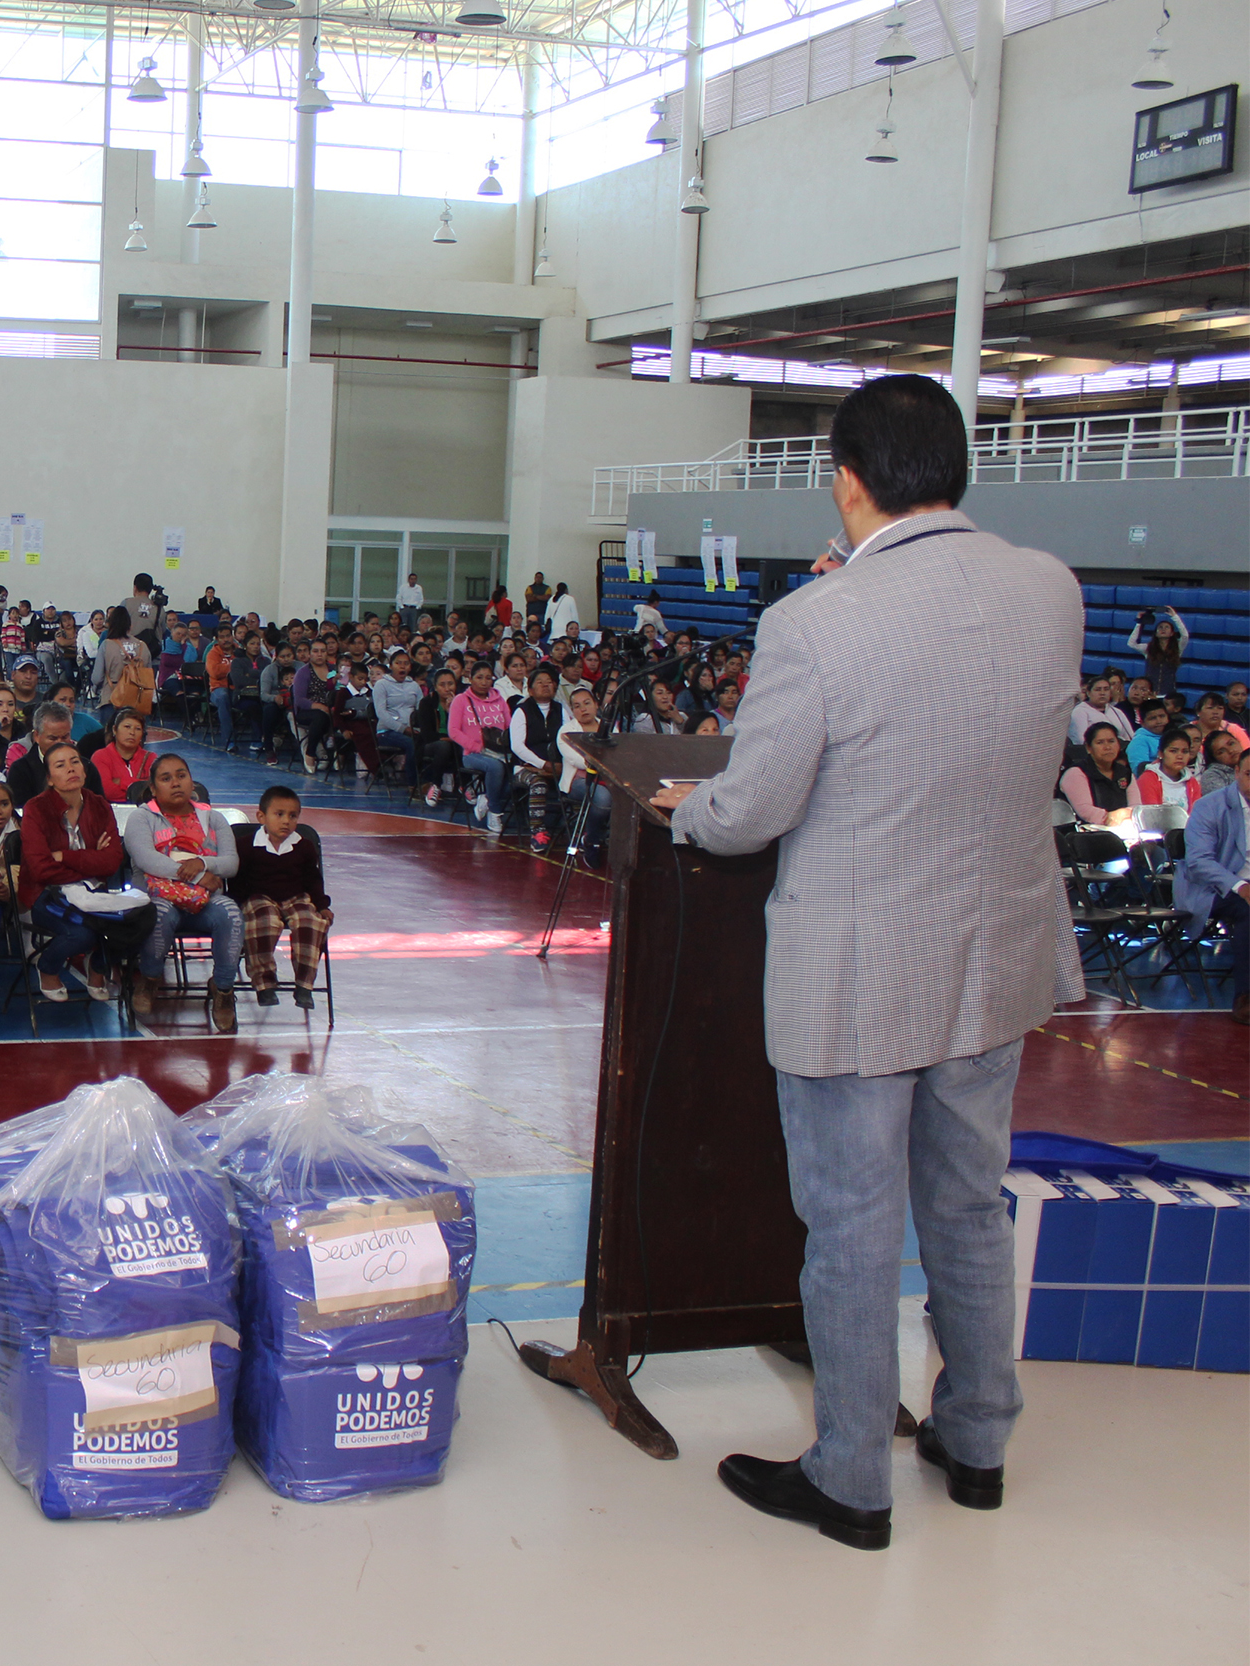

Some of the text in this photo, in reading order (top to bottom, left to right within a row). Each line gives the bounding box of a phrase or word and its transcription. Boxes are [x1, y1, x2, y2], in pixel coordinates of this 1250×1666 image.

[1197, 133, 1223, 146] VISITA
[1135, 149, 1159, 162] LOCAL
[97, 1216, 195, 1245] UNIDOS
[103, 1234, 201, 1263] PODEMOS
[313, 1228, 416, 1262] Secundaria
[116, 1266, 126, 1274] El
[127, 1261, 166, 1272] Gobierno
[362, 1250, 408, 1283] 60
[86, 1340, 202, 1379] Secundaria
[135, 1367, 176, 1395] 60
[337, 1388, 434, 1412] UNIDOS
[336, 1407, 431, 1431] PODEMOS
[73, 1429, 179, 1452] PODEMOS
[340, 1436, 349, 1444] El
[350, 1434, 390, 1444] Gobierno
[390, 1432, 400, 1440] de
[78, 1455, 173, 1465] El Gobierno de Todos
